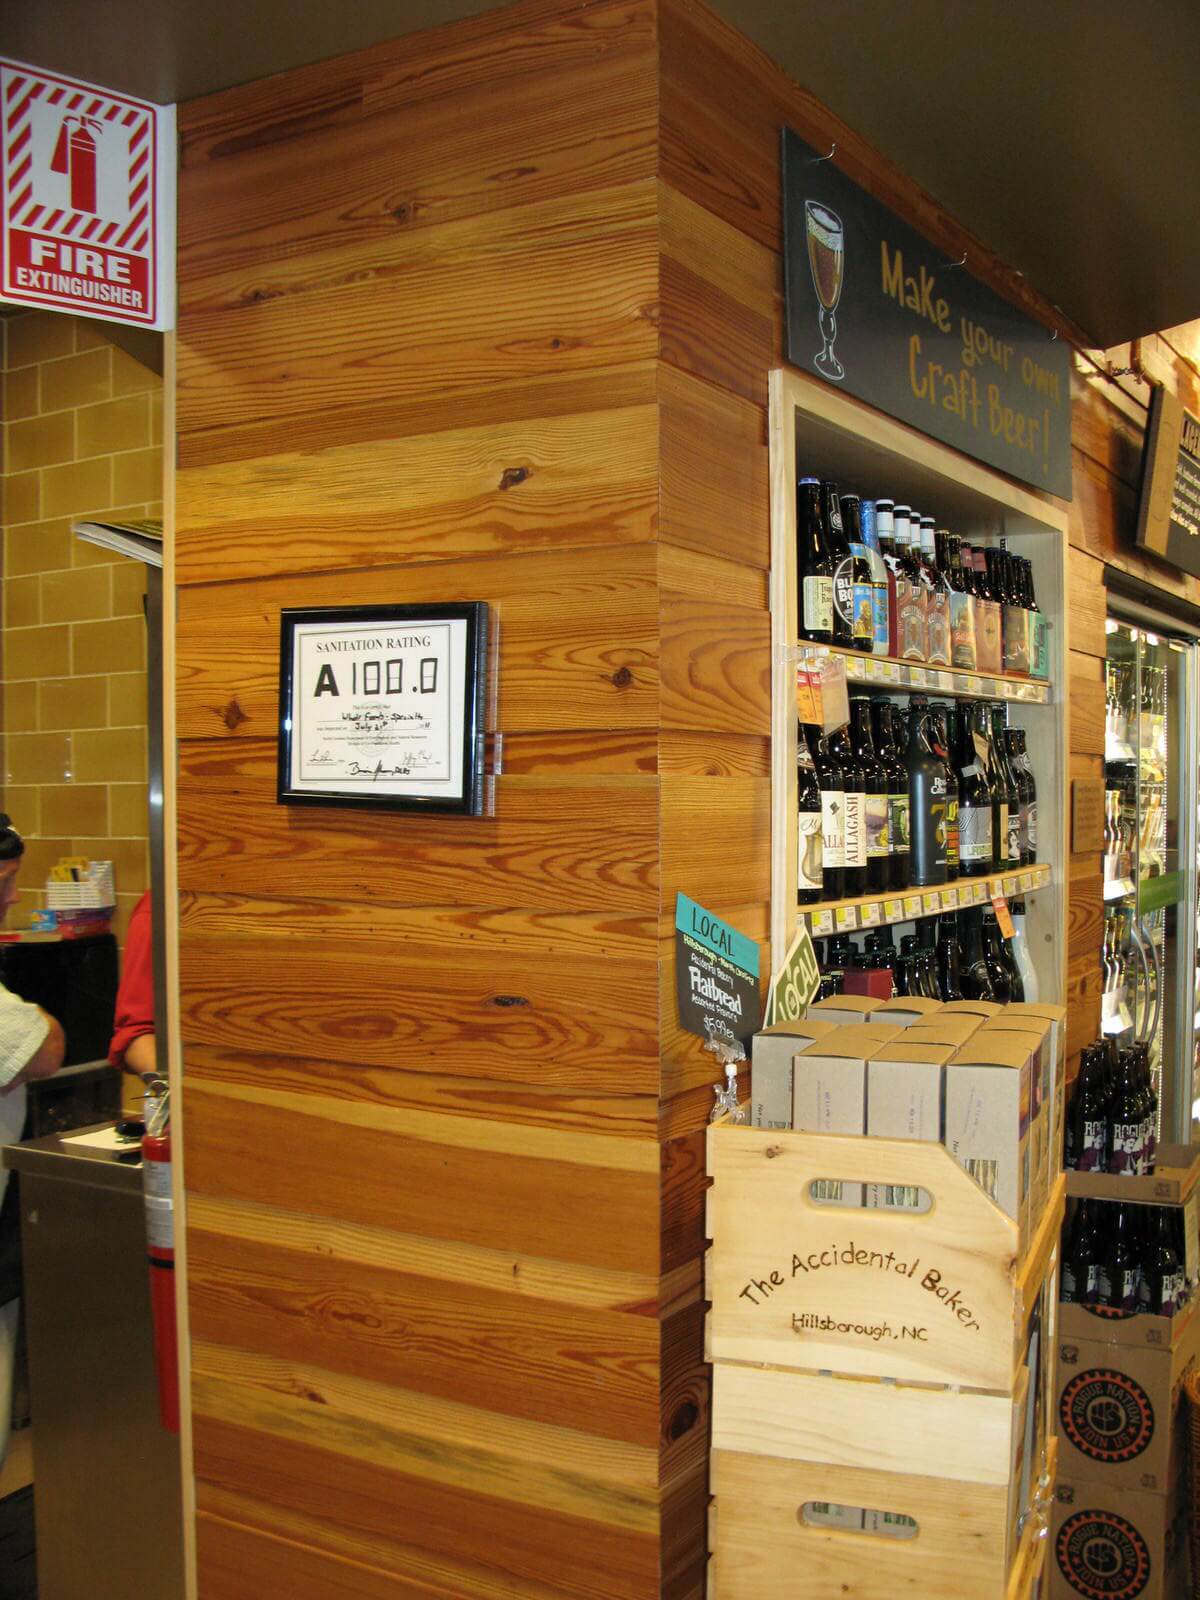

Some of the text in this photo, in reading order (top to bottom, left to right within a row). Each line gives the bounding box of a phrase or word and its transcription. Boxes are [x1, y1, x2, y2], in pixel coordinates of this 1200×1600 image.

[30, 238, 131, 284] FIRE
[16, 266, 143, 309] EXTINGUISHER
[881, 240, 1060, 405] Make your own
[909, 334, 1051, 477] Craft Beer!
[316, 635, 432, 653] SANITATION RATING
[313, 657, 438, 698] A 100.0
[846, 796, 859, 864] ALLAGASH
[691, 906, 736, 957] LOCAL
[688, 965, 743, 1016] Flatbread
[739, 1241, 980, 1332] The Accidental Baker
[791, 1313, 929, 1342] Hillsborough, NC
[1106, 1383, 1142, 1426] NATION
